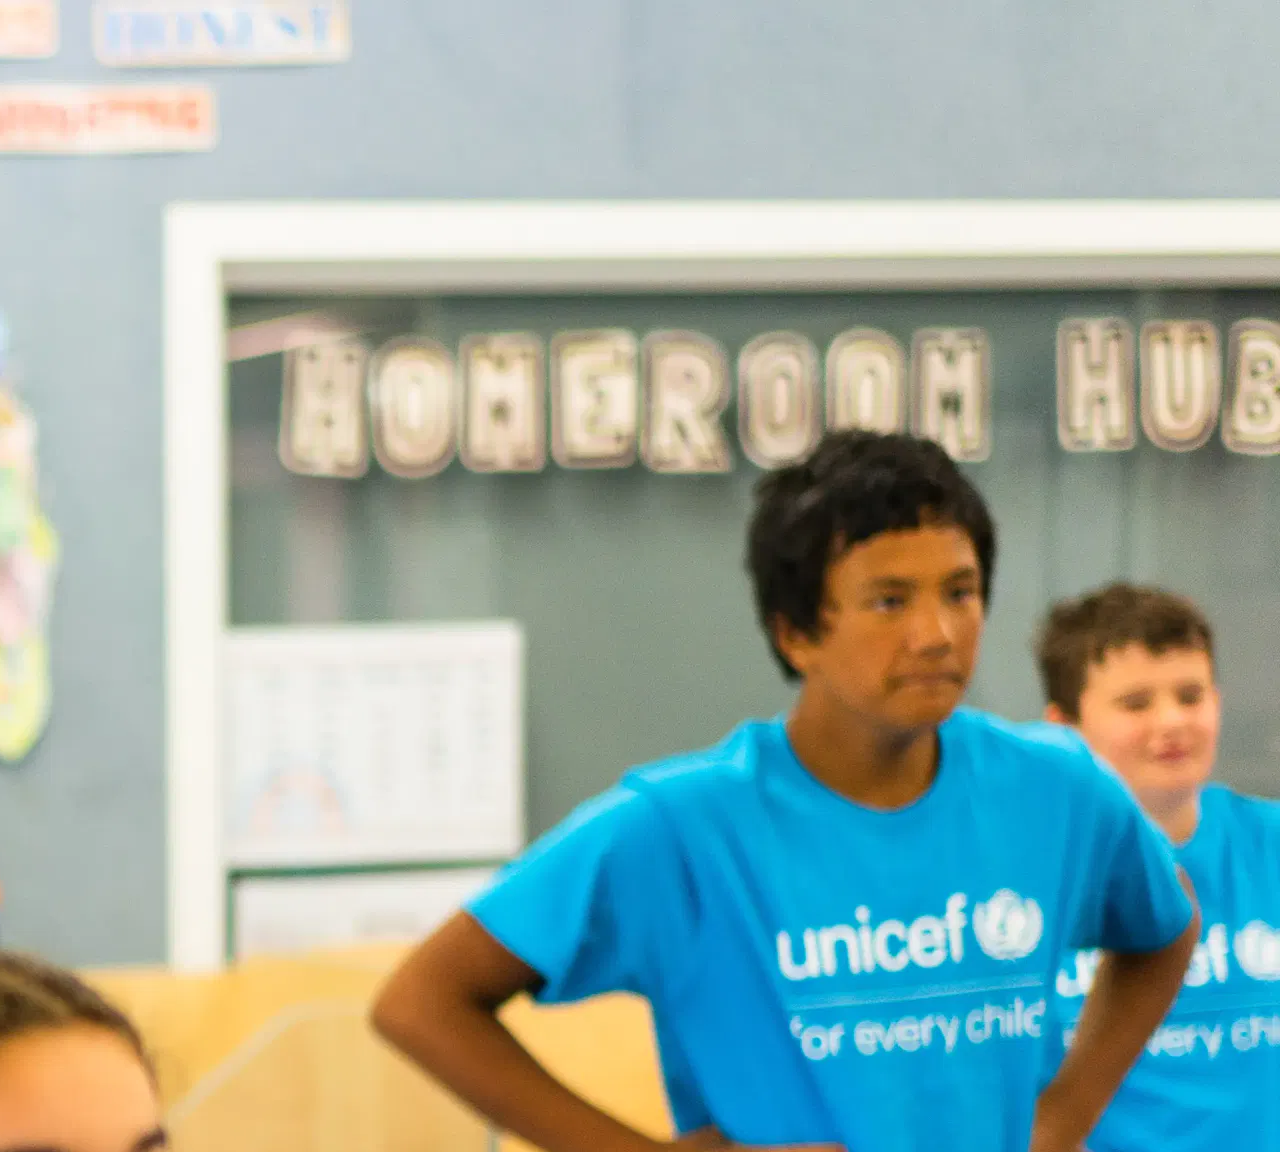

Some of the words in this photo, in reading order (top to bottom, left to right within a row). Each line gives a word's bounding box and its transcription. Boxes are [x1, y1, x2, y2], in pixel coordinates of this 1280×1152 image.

[278, 325, 992, 480] HOMEROOM
[1056, 316, 1280, 456] HUB
[777, 892, 968, 981] unicef
[854, 1013, 960, 1055] every
